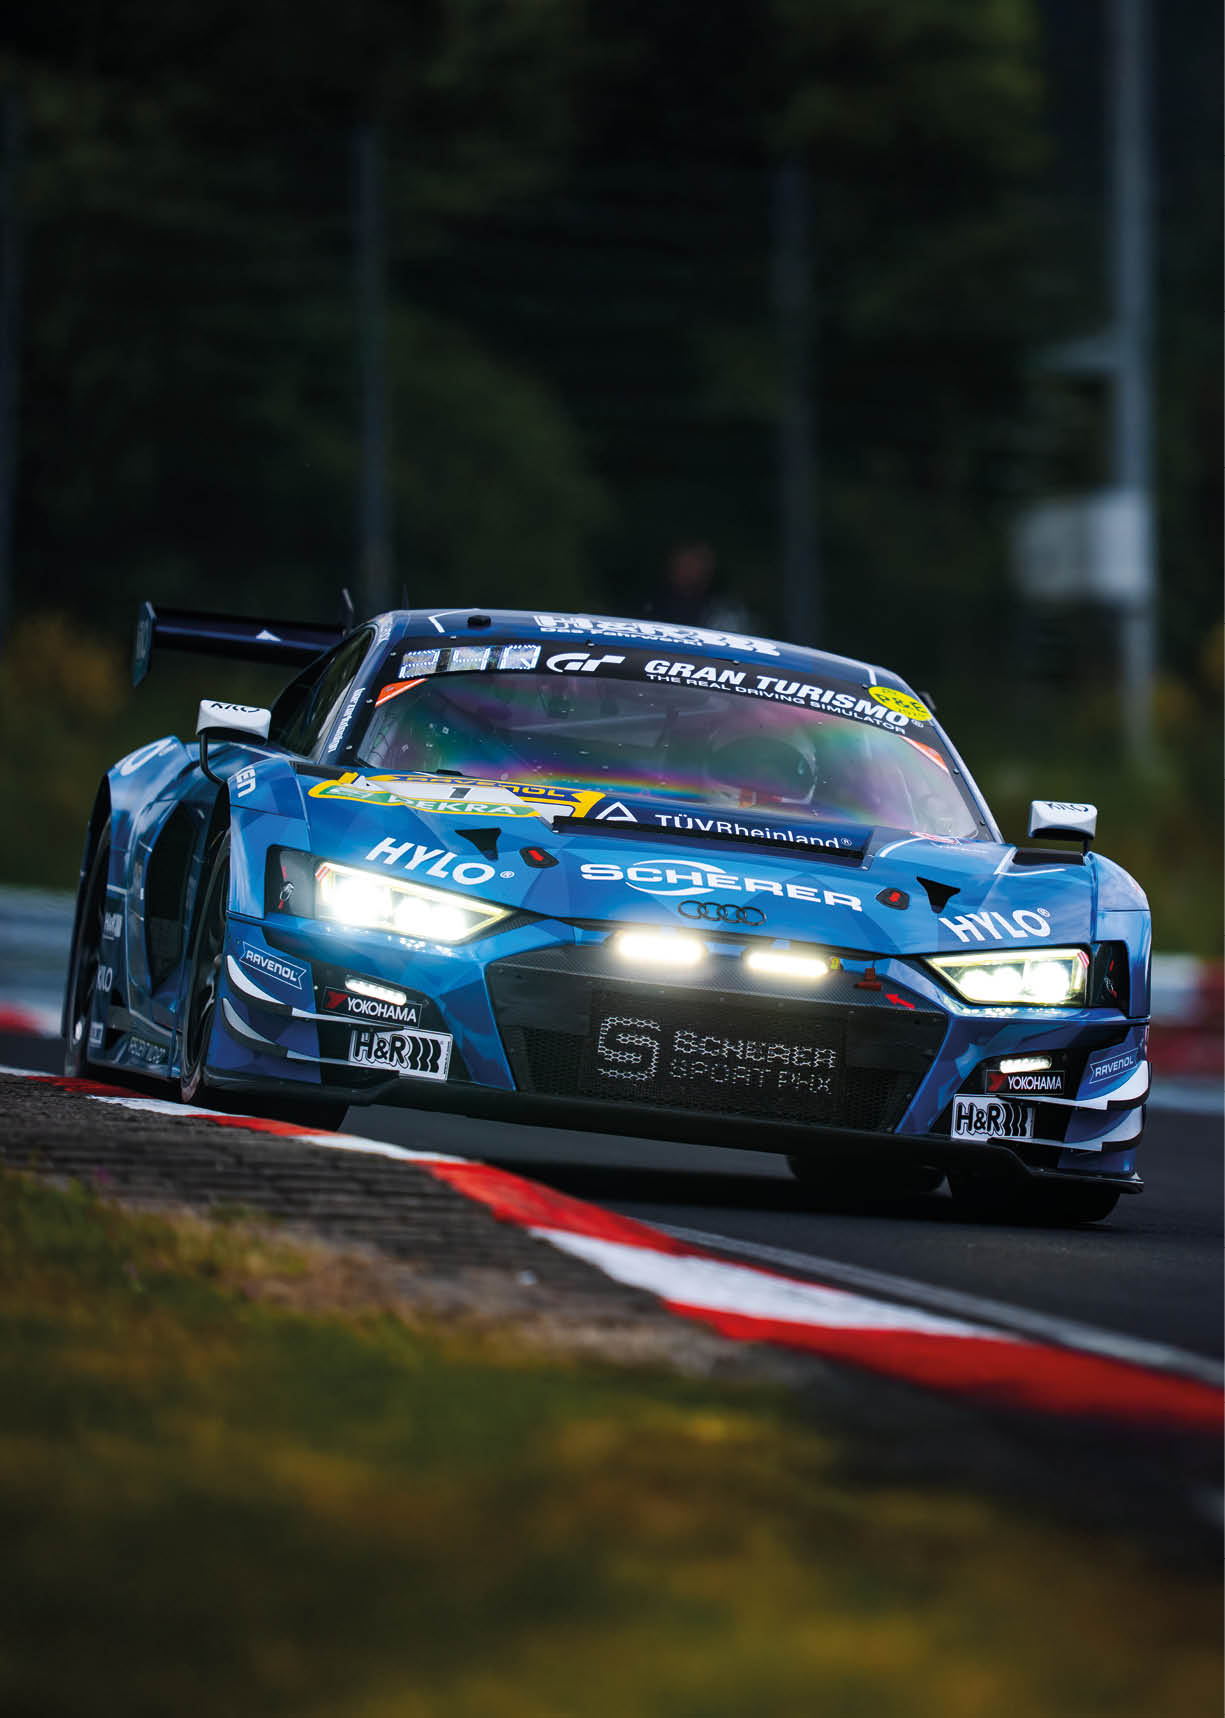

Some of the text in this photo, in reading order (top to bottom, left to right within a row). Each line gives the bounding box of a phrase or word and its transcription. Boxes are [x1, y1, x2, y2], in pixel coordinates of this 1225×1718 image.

[644, 659, 747, 685] GRAN
[646, 673, 681, 684] THE
[686, 678, 732, 690] REAL
[735, 686, 806, 705] DRIVING
[809, 700, 906, 735] SIMULATOR
[580, 863, 863, 912] SCHERER
[245, 949, 298, 983] RAVENOL
[347, 996, 417, 1023] YOKOHAMA
[353, 1030, 410, 1070] H&R
[673, 1029, 837, 1069] SCHERER
[1094, 1054, 1135, 1078] RAVENOL
[1007, 1075, 1062, 1091] YOKOHAMA
[955, 1101, 1007, 1136] H&R
